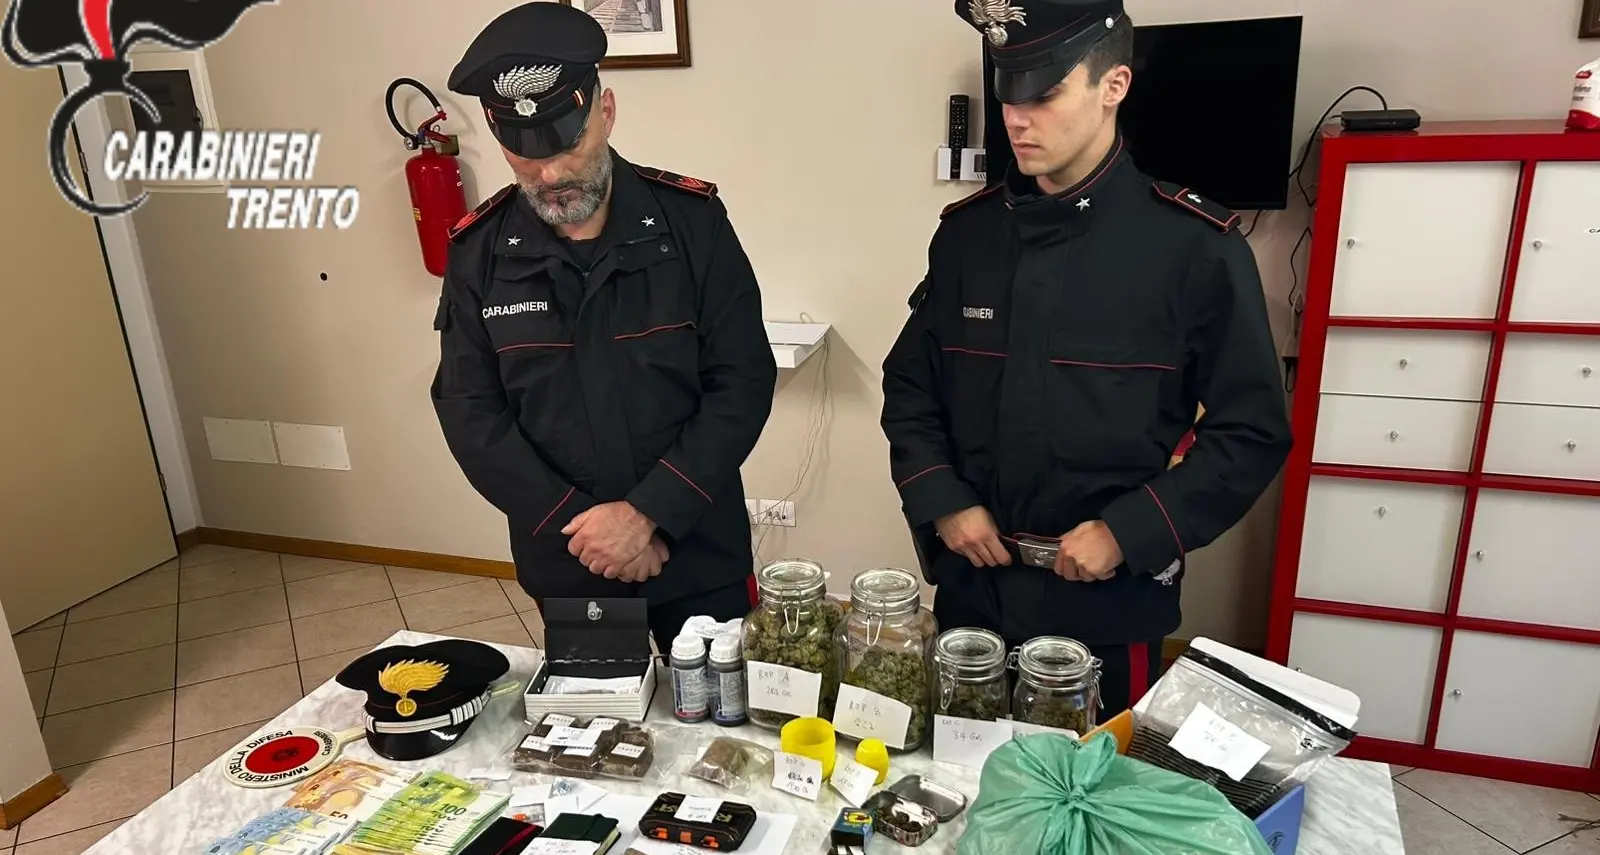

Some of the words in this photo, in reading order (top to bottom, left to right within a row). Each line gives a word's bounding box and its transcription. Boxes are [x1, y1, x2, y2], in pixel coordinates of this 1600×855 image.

[482, 301, 548, 319] CARABINIERI
[246, 730, 294, 749] DIFESA
[229, 749, 249, 775] DELLA
[237, 765, 310, 783] MINISTERO
[440, 803, 467, 816] 100
